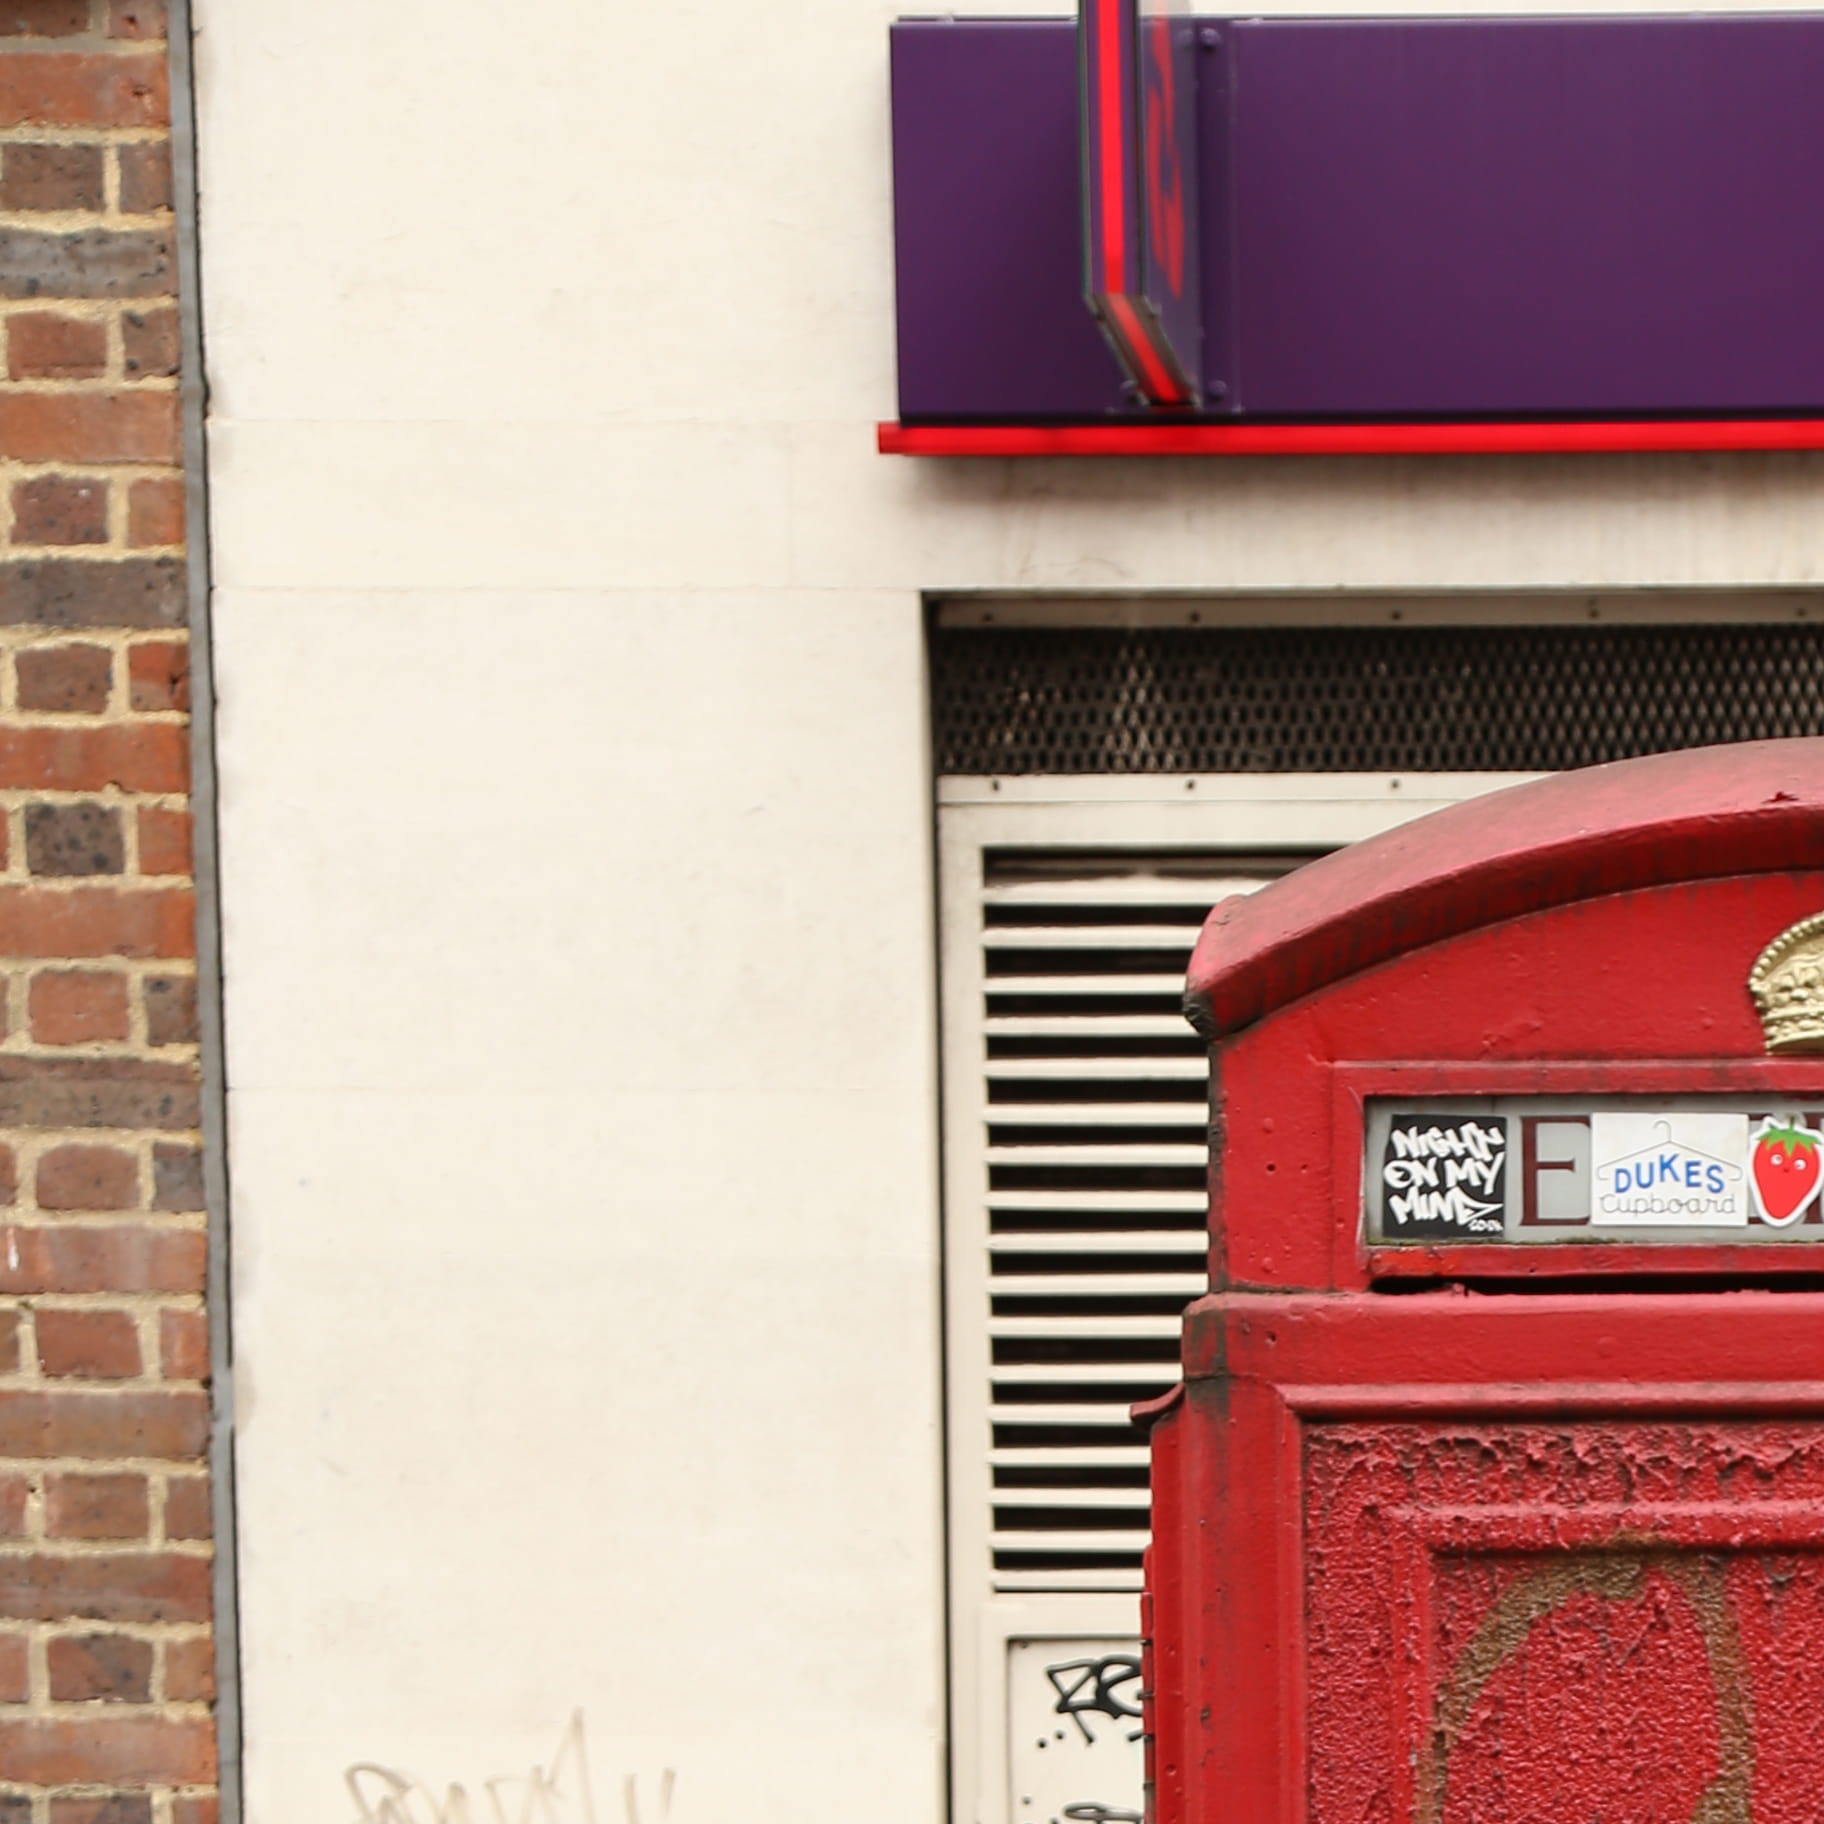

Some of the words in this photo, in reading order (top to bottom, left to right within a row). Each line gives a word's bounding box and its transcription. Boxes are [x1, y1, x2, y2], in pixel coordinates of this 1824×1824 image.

[1391, 1121, 1505, 1161] NIGHT
[1383, 1157, 1440, 1188] ON
[1444, 1152, 1505, 1195] MY
[1614, 1153, 1725, 1193] DUKES
[1389, 1186, 1504, 1225] MIND
[1600, 1193, 1736, 1218] Cupboard
